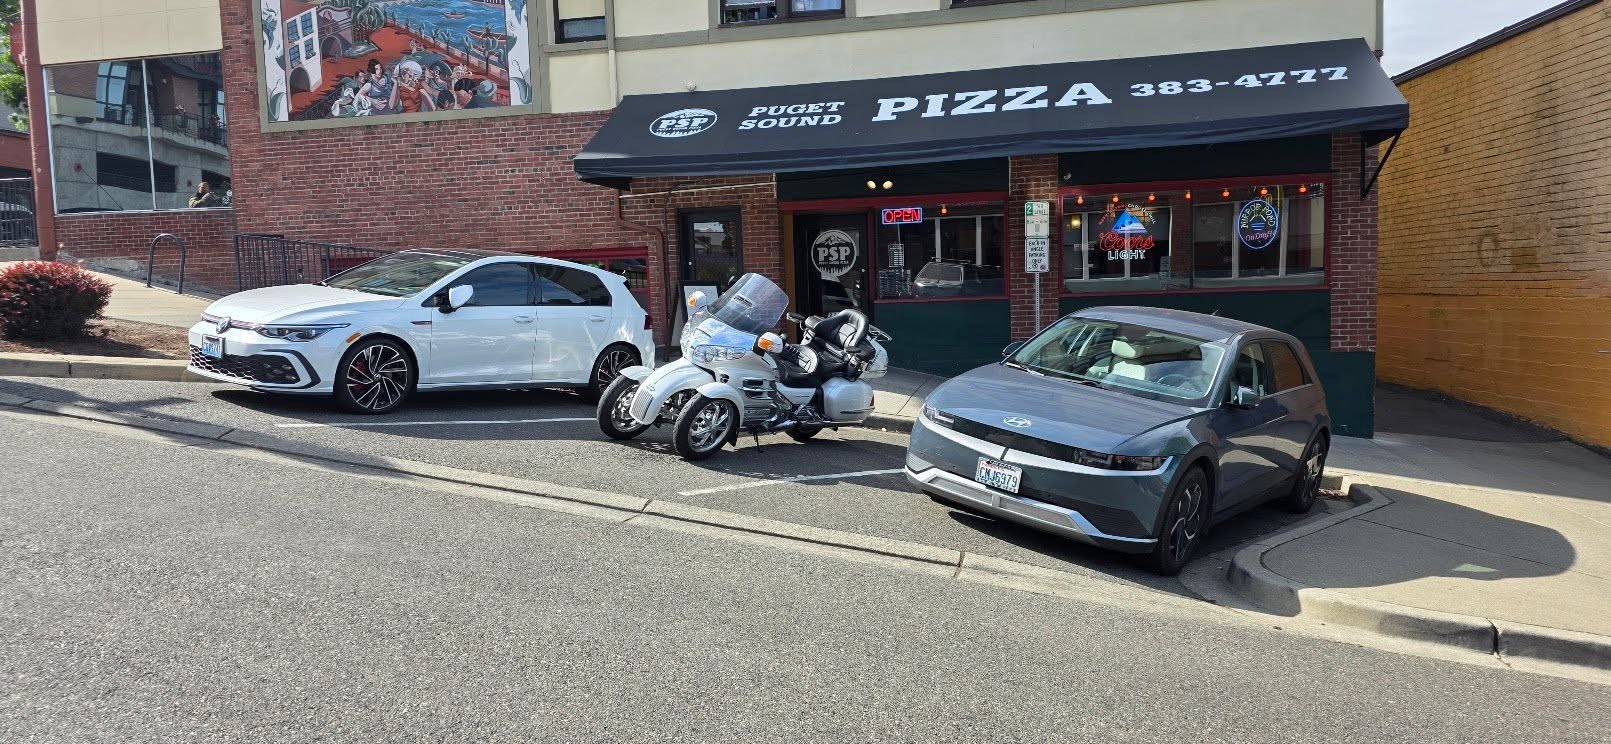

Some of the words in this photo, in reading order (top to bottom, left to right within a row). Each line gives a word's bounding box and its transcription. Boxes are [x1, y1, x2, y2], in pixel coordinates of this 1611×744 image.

[1130, 66, 1349, 98] 383-4777
[748, 101, 846, 117] PUGET
[872, 81, 1113, 122] PIZZA
[658, 117, 709, 129] PSP
[738, 114, 842, 130] SOUND
[884, 209, 920, 222] OPEN
[1026, 203, 1032, 214] 2
[1099, 231, 1155, 251] Coors
[817, 246, 851, 262] PSP
[1108, 249, 1146, 260] LIGHT
